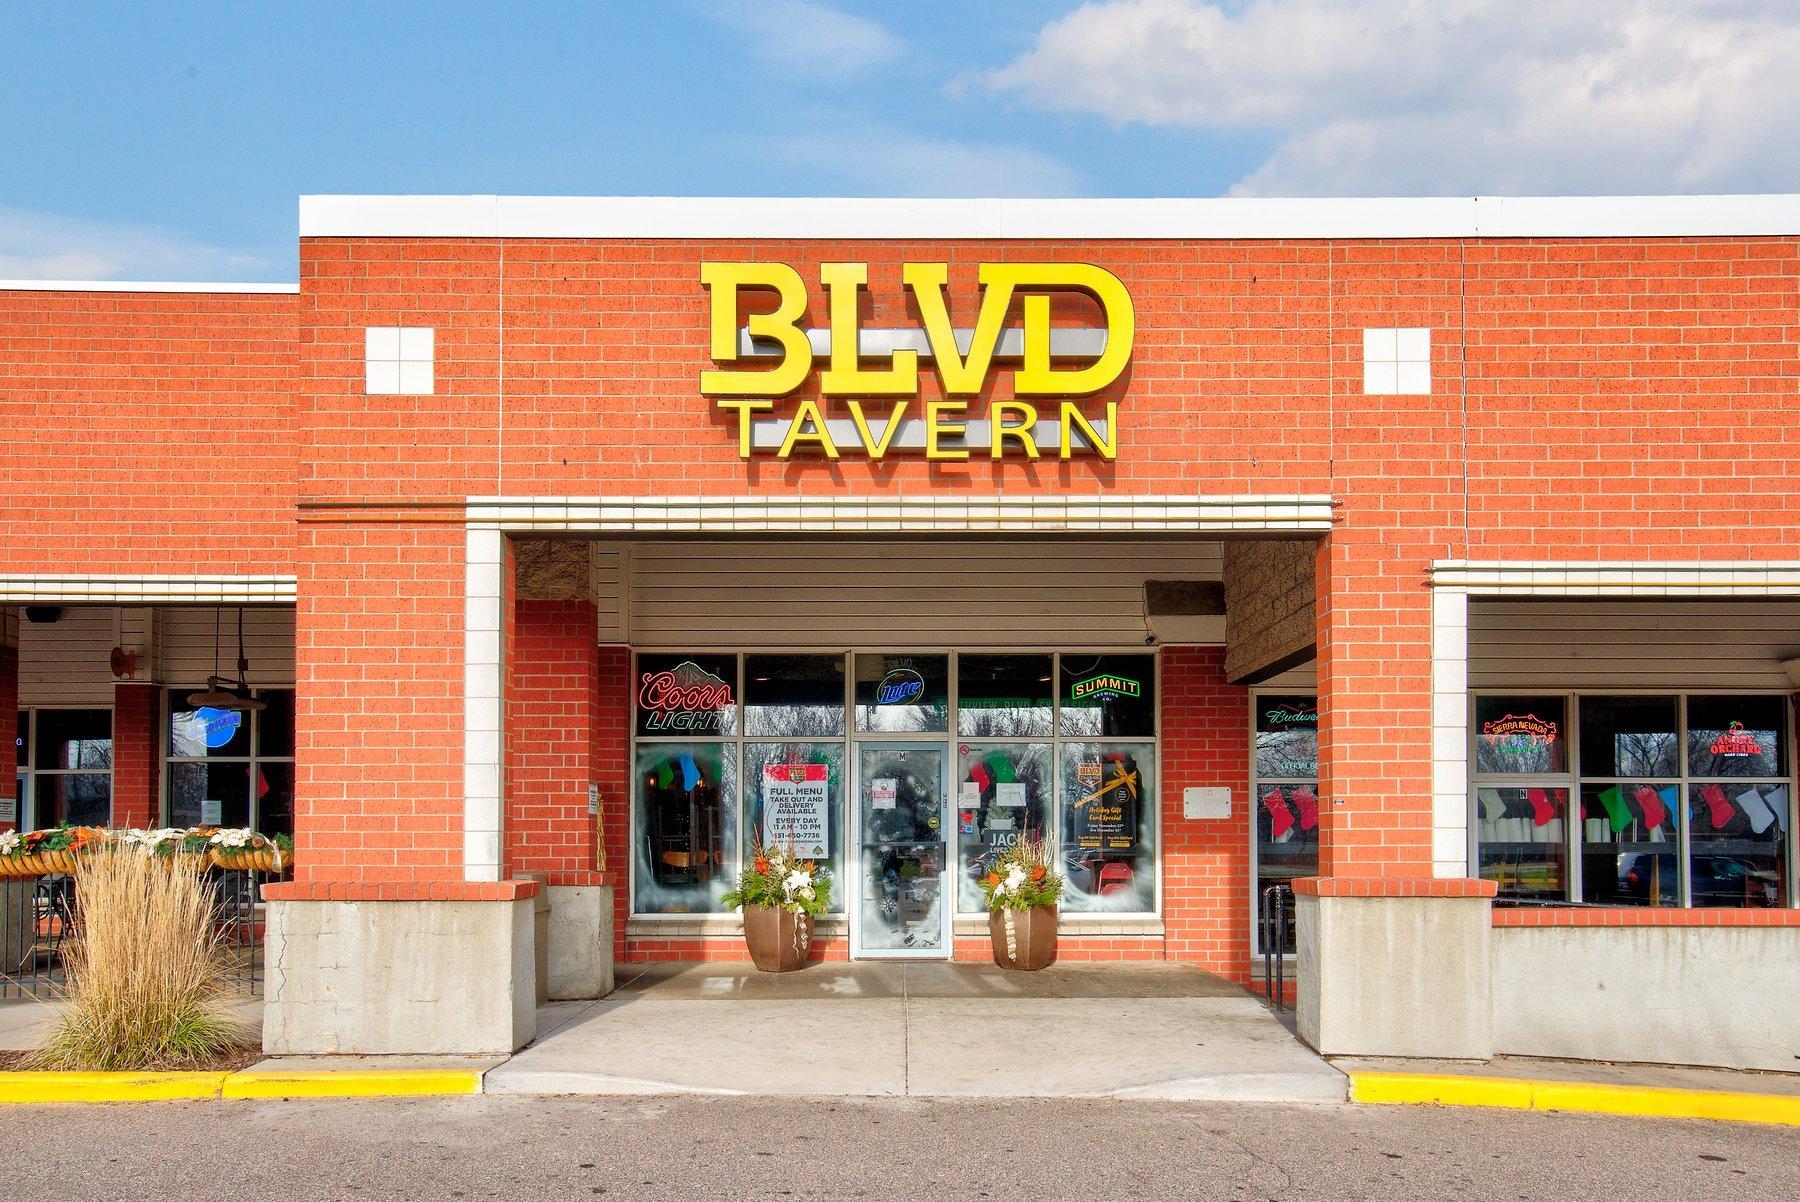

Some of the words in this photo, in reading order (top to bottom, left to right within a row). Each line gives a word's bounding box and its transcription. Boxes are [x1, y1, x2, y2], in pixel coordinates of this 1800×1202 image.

[700, 262, 1135, 395] BLVD
[717, 401, 1117, 462] TAVERN
[640, 672, 735, 710] Coors
[1075, 677, 1137, 696] SUMMIT
[646, 711, 727, 730] LIGHT
[1492, 721, 1519, 735] SIERRA
[1519, 721, 1548, 735] NEVADA
[899, 752, 906, 760] M
[1710, 745, 1762, 755] ORCHARD
